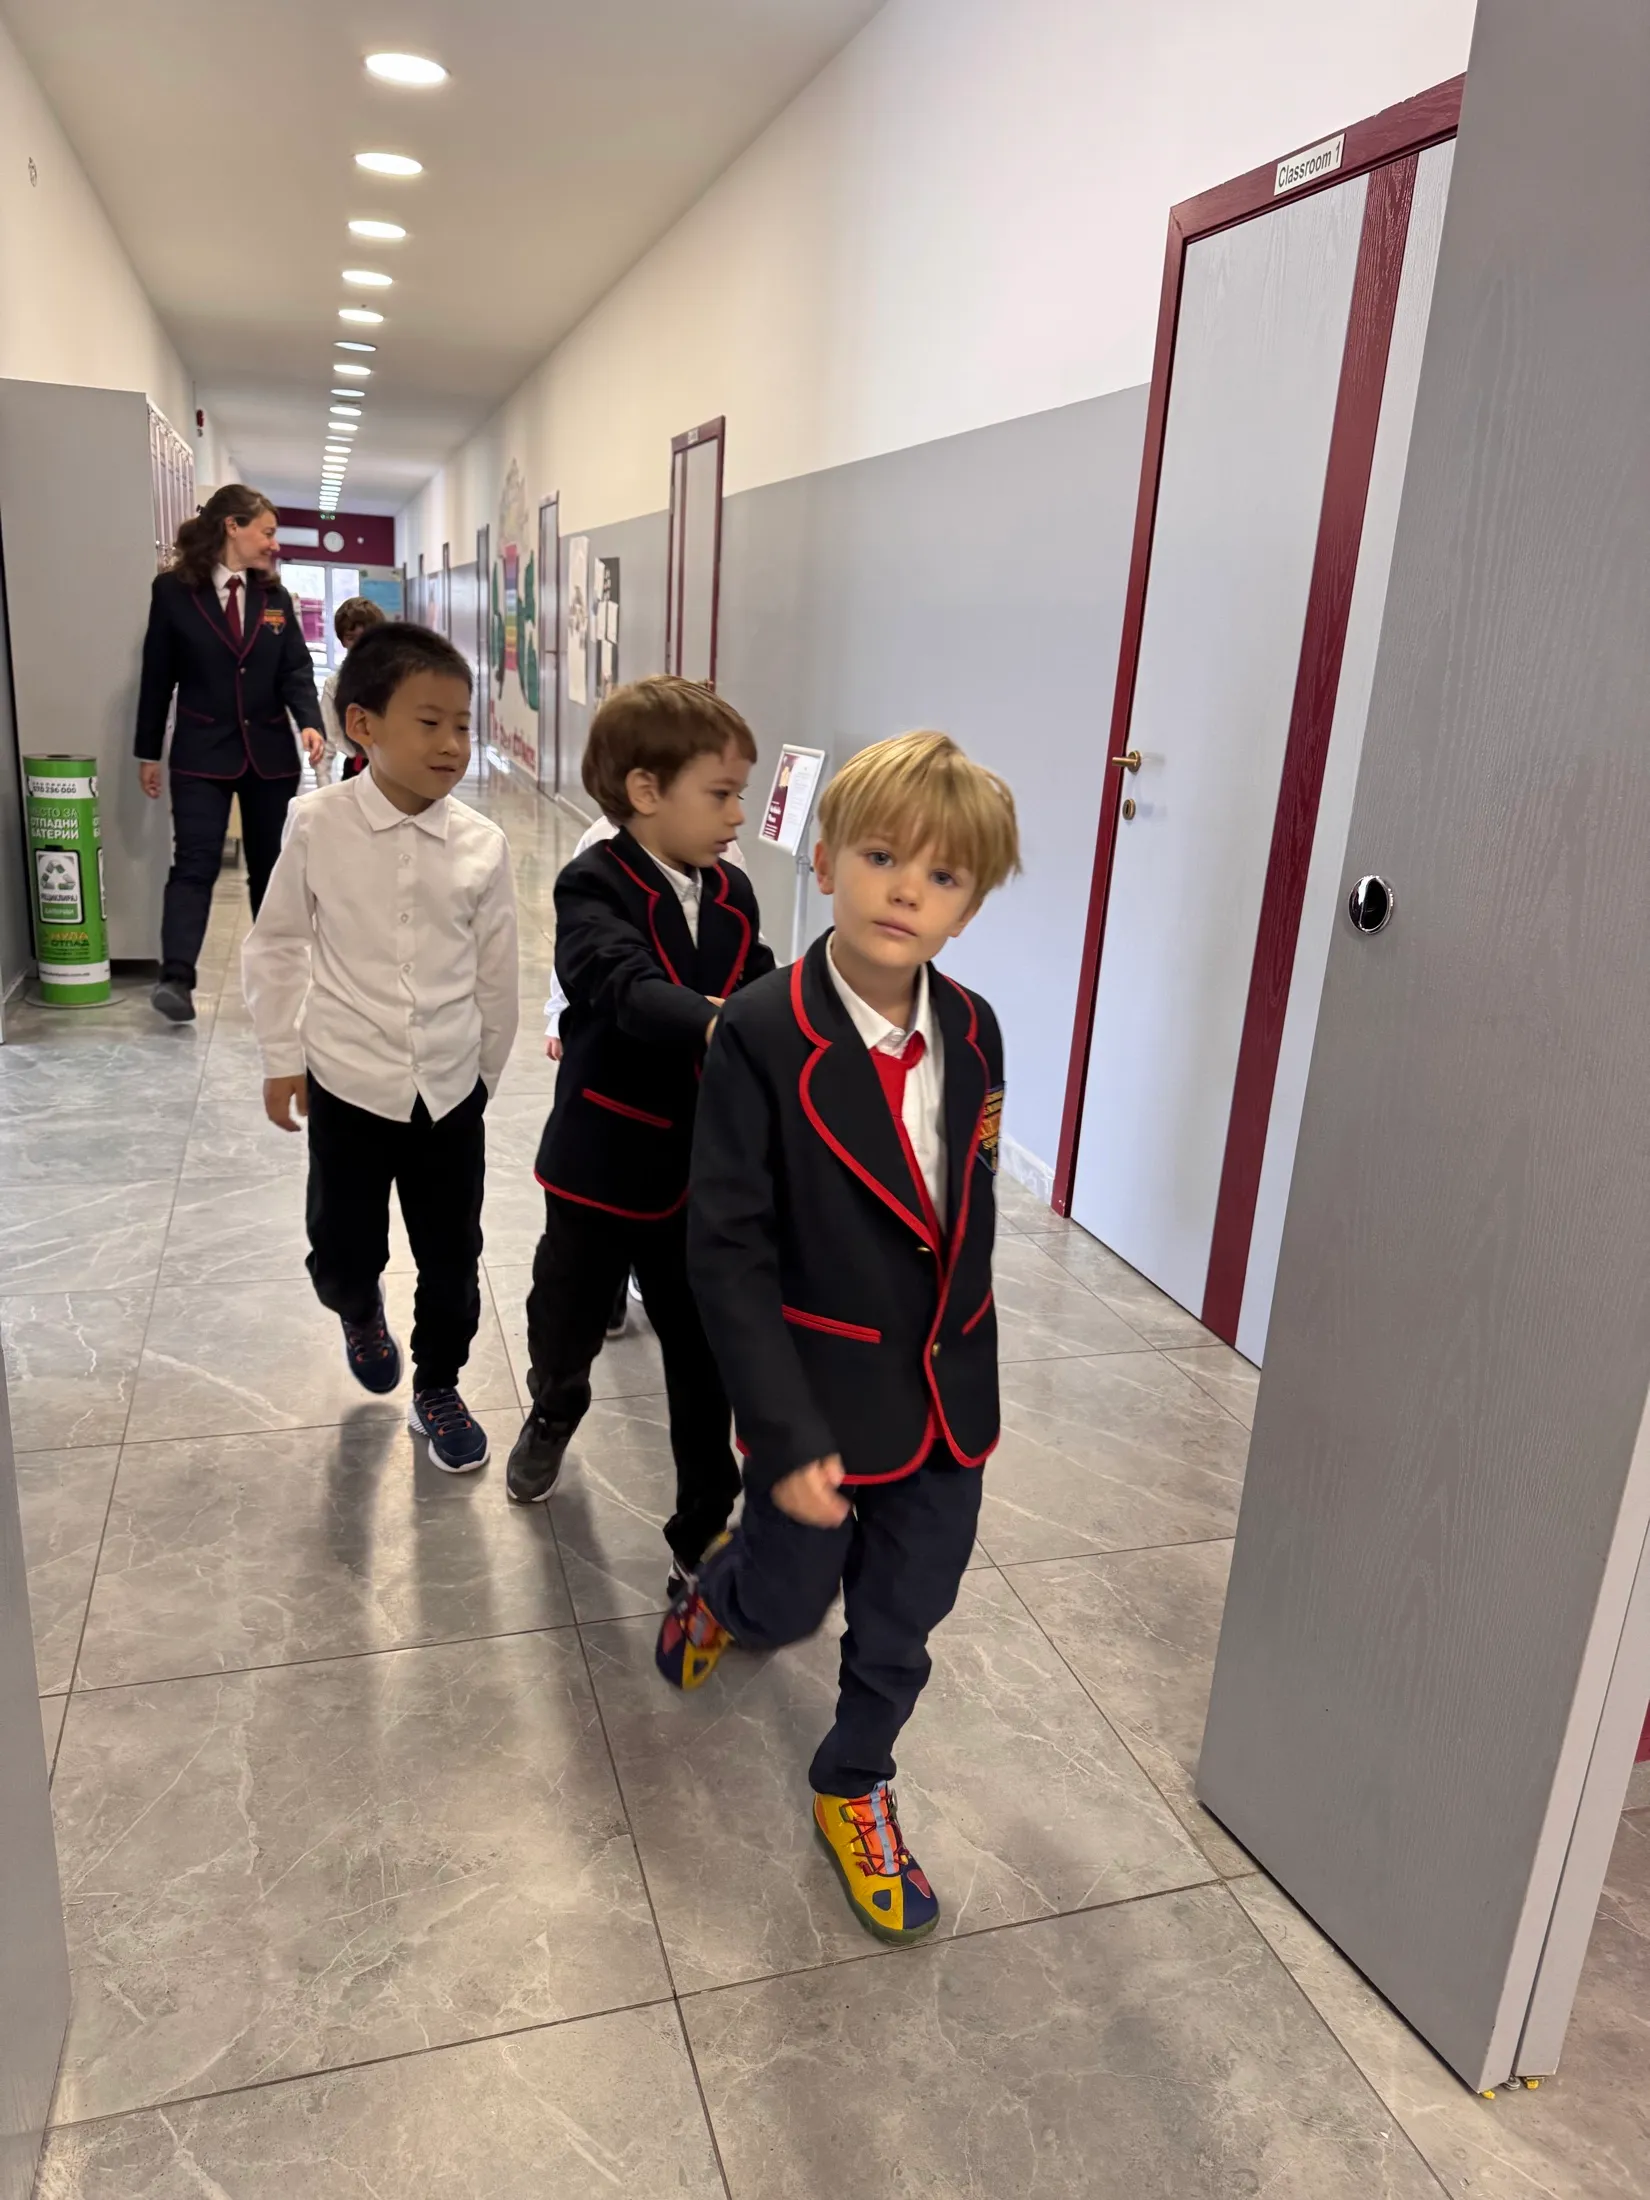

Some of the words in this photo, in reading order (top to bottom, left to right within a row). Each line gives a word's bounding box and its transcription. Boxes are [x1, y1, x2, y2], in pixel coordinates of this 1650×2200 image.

[1278, 150, 1332, 188] Classroom
[1335, 141, 1341, 163] 1
[63, 808, 78, 818] ЗА
